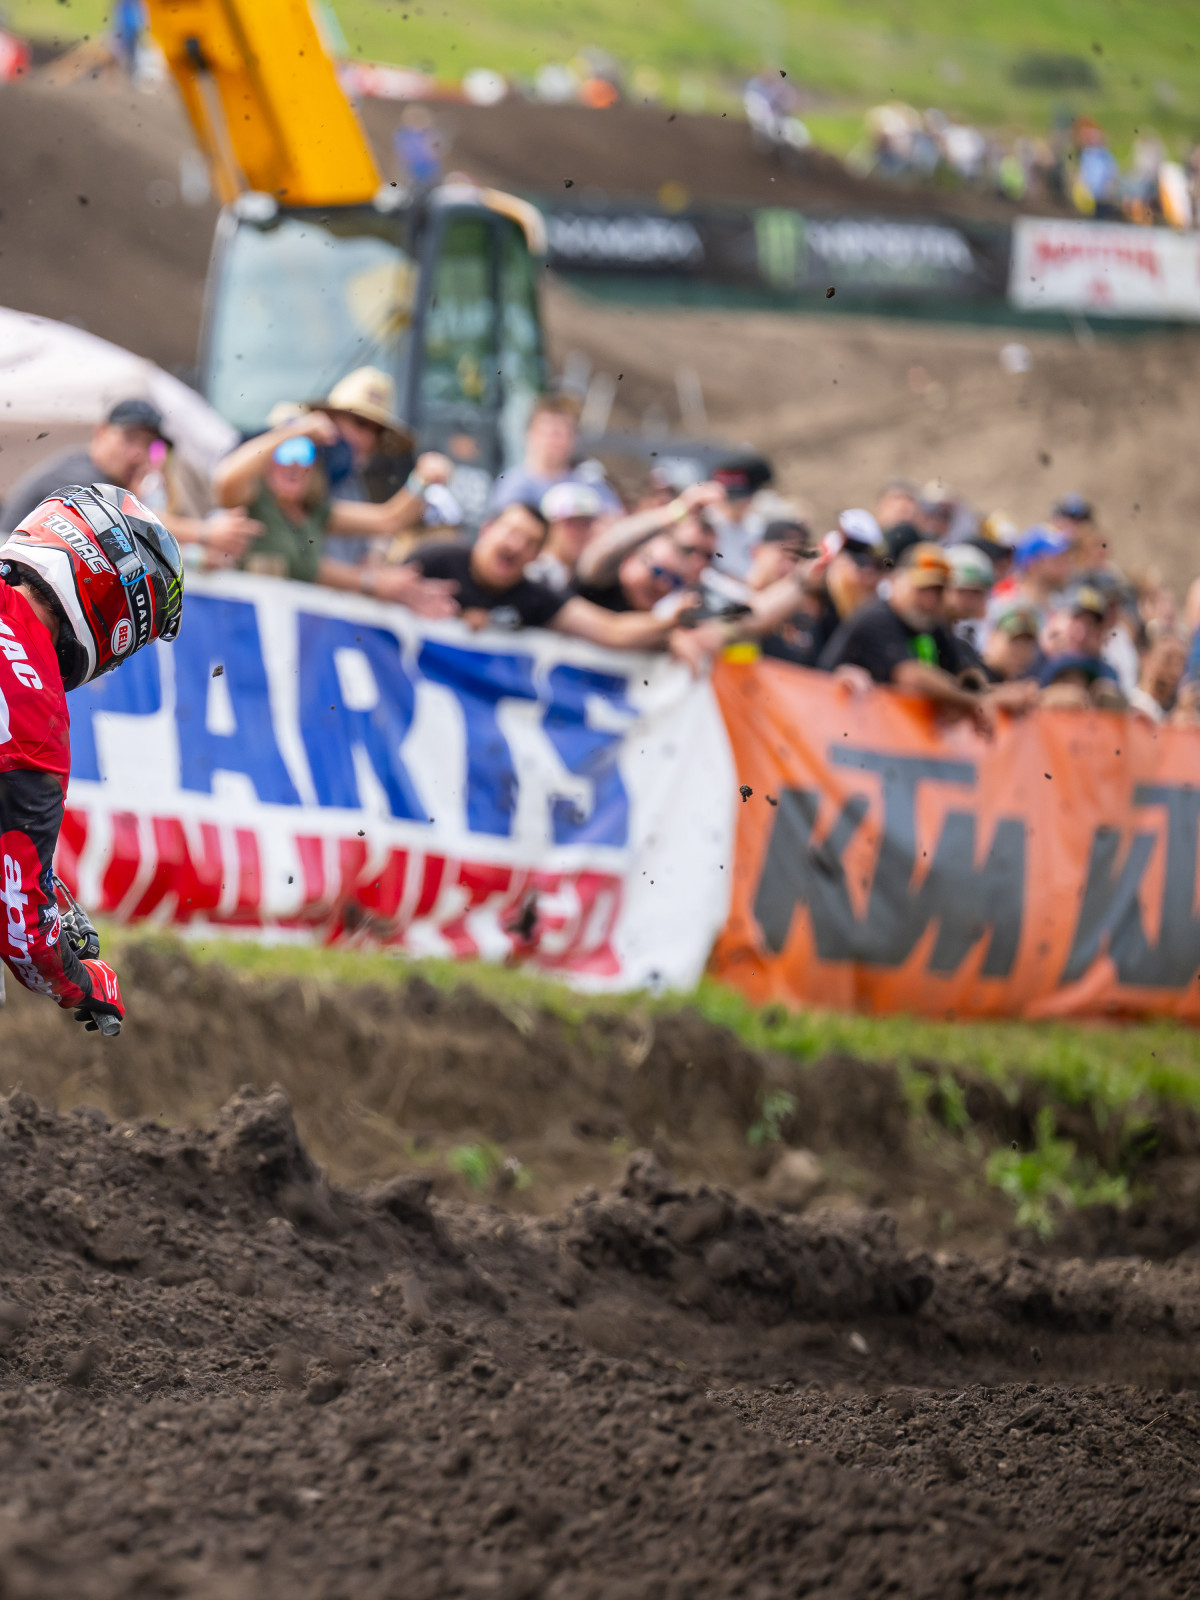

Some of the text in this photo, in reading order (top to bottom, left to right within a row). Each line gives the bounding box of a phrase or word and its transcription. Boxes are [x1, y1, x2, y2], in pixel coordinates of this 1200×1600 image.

[41, 514, 116, 575] TOMAC
[117, 624, 128, 652] BELL
[752, 743, 1027, 980] KTM
[1060, 784, 1200, 988] KT
